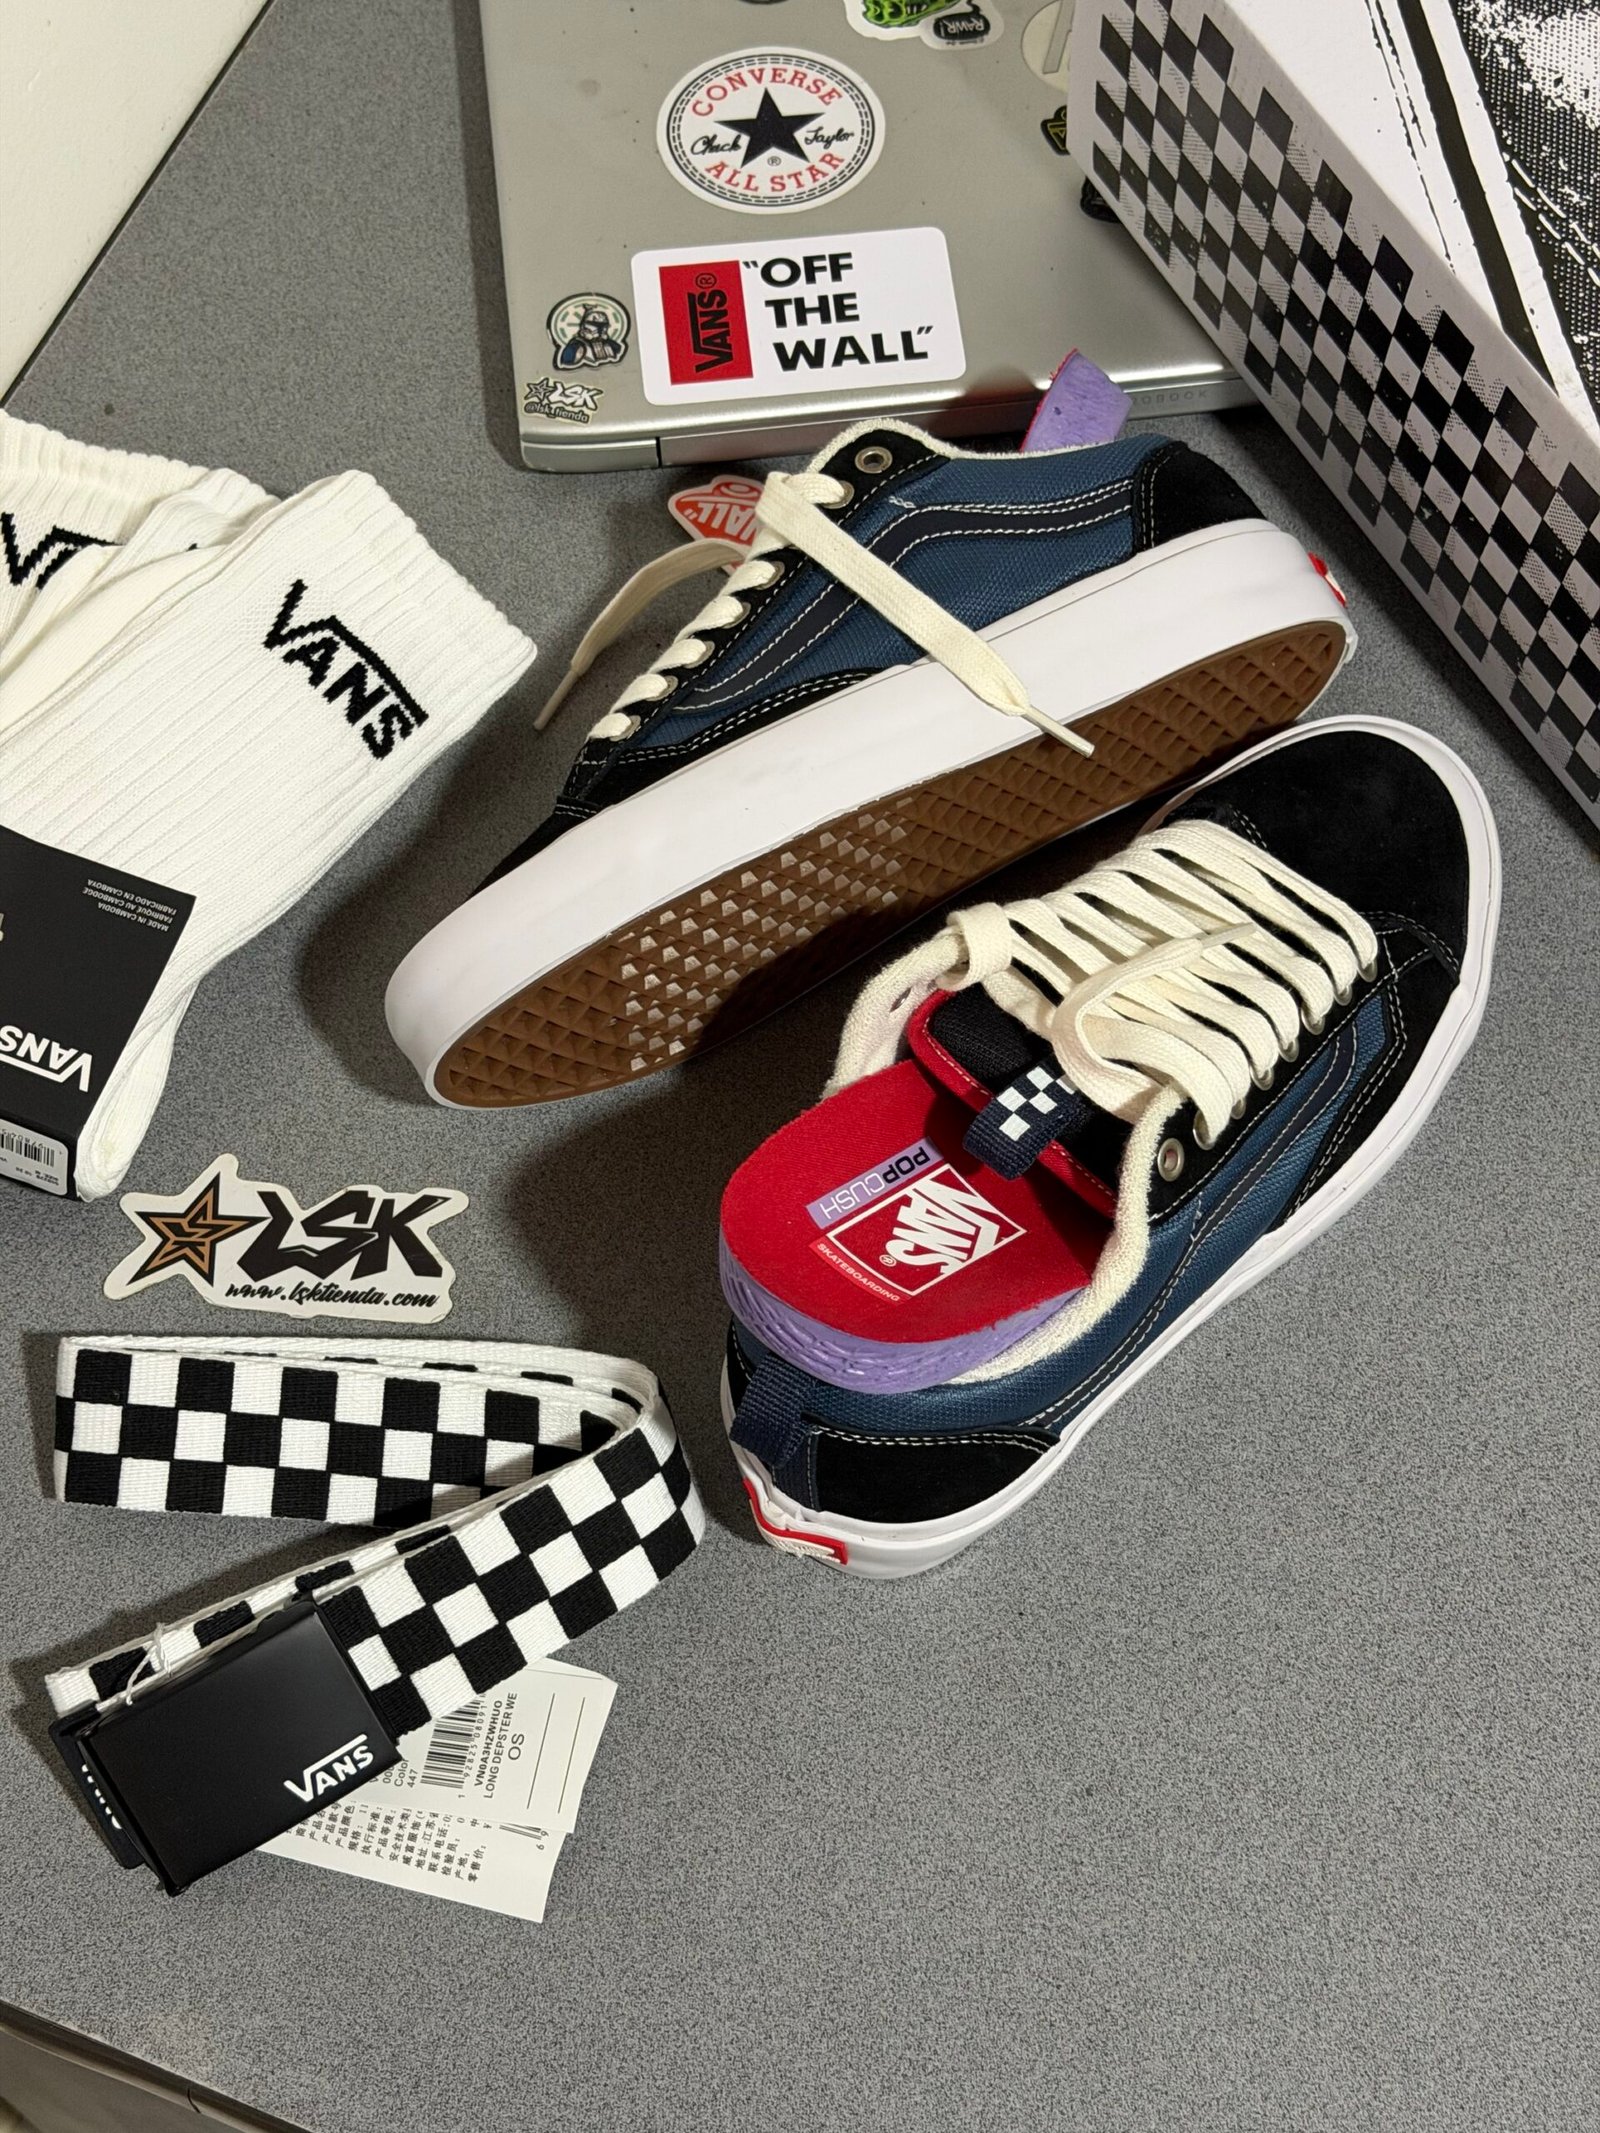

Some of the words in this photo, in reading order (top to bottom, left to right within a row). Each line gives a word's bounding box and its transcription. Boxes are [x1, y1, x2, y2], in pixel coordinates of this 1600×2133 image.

[692, 67, 843, 117] CONVERSE
[690, 134, 742, 155] Chuck
[804, 126, 855, 150] Taylor
[705, 161, 759, 193] ALL
[770, 151, 845, 193] STAR
[764, 292, 860, 329] THE
[262, 579, 430, 761] VANS
[82, 886, 125, 907] CAMBODGE
[87, 879, 123, 897] CAMBOYA
[123, 891, 135, 901] EN
[97, 901, 137, 921] CAMBODIA
[125, 902, 136, 911] AU
[135, 896, 177, 915] FABRICADO
[137, 915, 147, 925] IN
[146, 919, 169, 932] MADE
[0, 1024, 93, 1093] VANS
[237, 1190, 452, 1282] LSK
[885, 1178, 1001, 1275] VANS
[817, 1243, 900, 1302] SKATEBOARDING
[225, 1281, 439, 1308] www.lsktienda.com
[484, 1766, 499, 1798] LONG
[492, 1712, 512, 1764] DEPSTER
[505, 1693, 517, 1709] WE
[508, 1734, 524, 1760] OS
[283, 1734, 374, 1802] VANS
[394, 1757, 409, 1787] Color
[407, 1769, 418, 1788] 447
